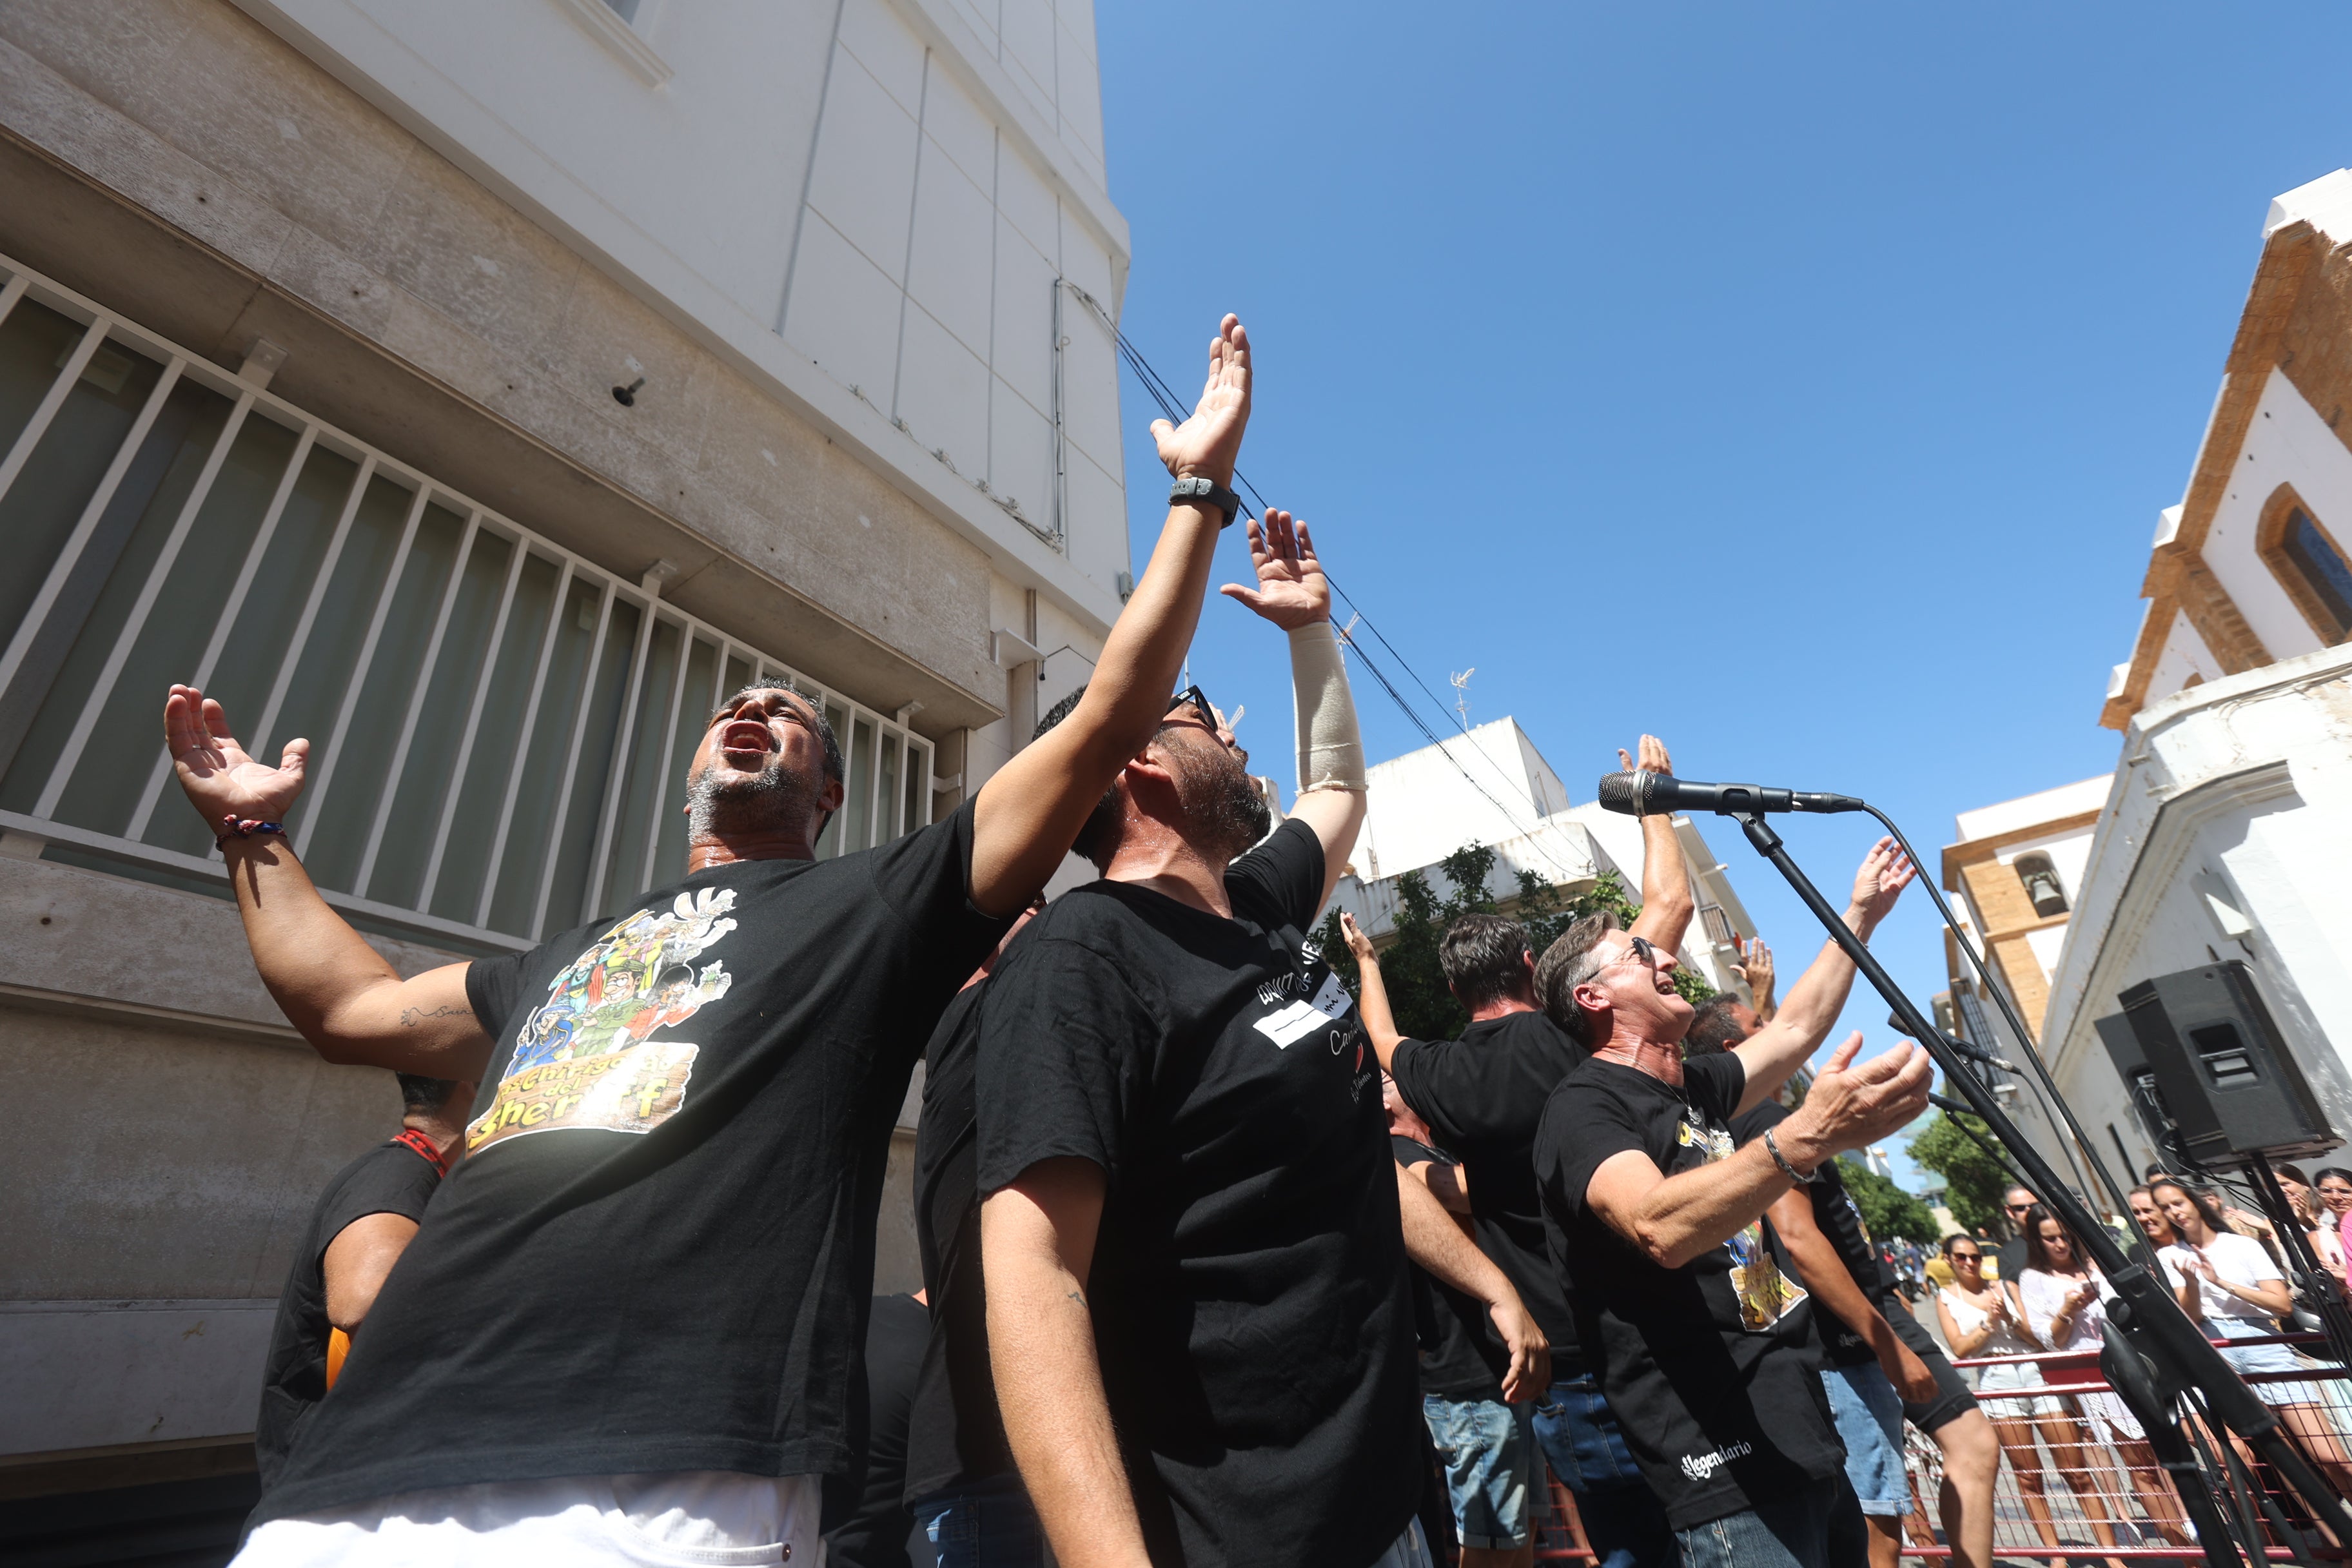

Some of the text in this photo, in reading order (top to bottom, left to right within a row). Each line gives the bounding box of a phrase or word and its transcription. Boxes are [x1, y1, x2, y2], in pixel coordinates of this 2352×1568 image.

[522, 1055, 676, 1093] Chirigoas
[468, 1077, 669, 1150] Sherff
[1685, 1438, 1752, 1479] Legendario
